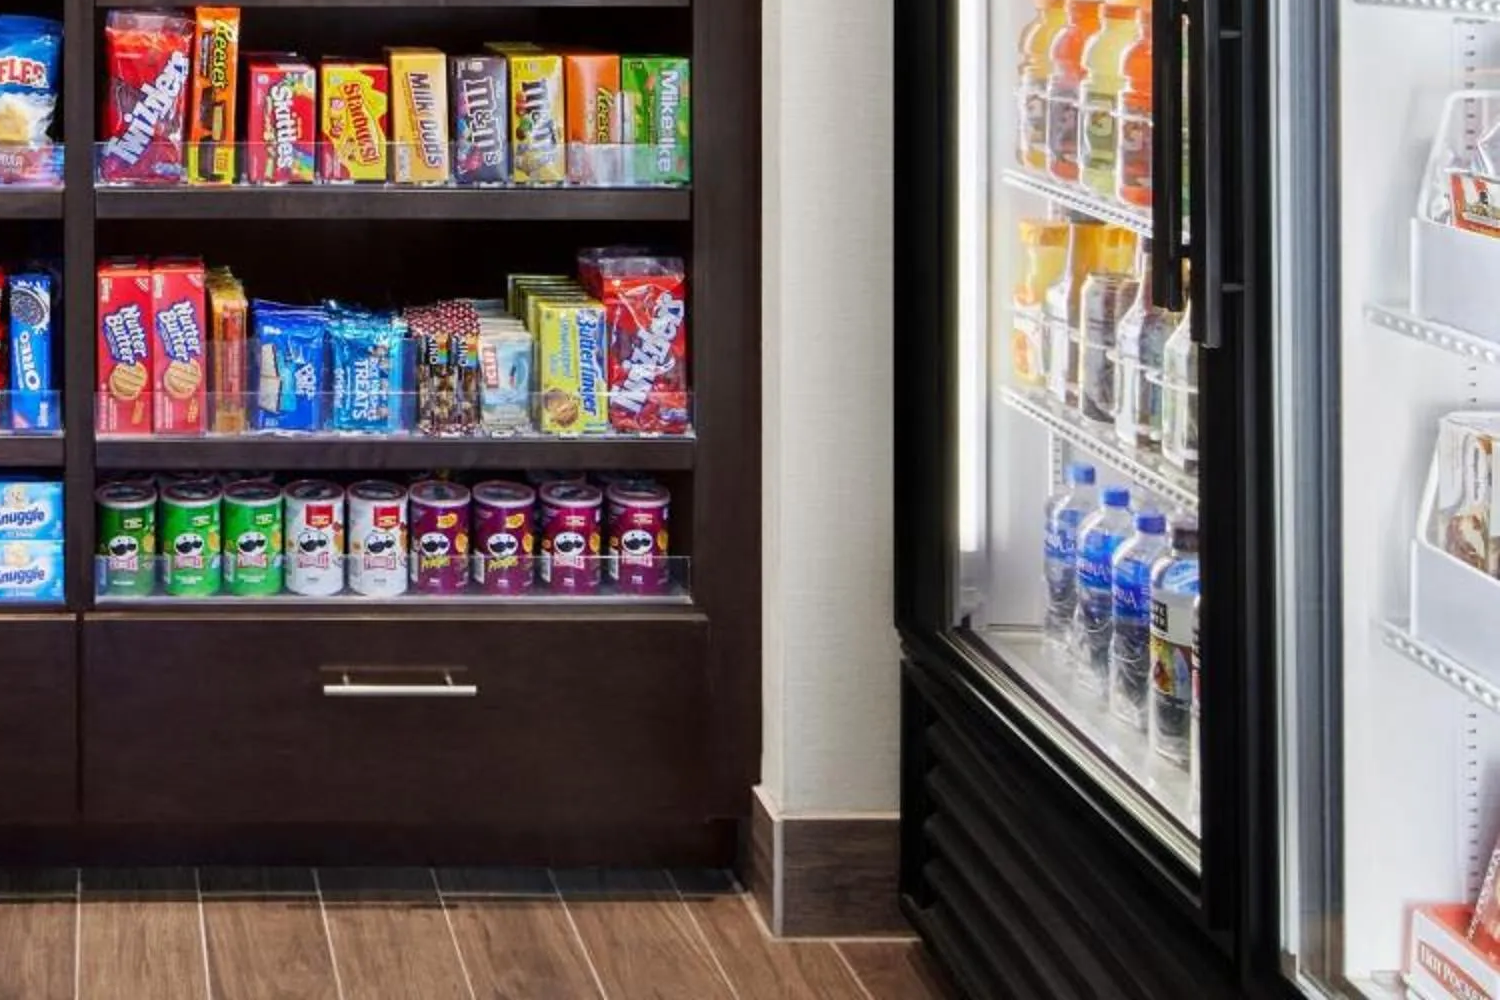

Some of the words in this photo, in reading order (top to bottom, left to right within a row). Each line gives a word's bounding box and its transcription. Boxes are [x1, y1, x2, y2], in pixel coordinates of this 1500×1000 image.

[211, 19, 238, 90] Reese's
[270, 85, 297, 169] Skittles
[104, 312, 136, 363] Butter
[119, 303, 147, 358] Nutter
[158, 309, 190, 361] Butter
[172, 299, 202, 355] Nutter
[429, 336, 440, 366] KIND
[19, 331, 42, 392] OREO
[353, 357, 368, 420] TREATS
[577, 310, 597, 417] Butterfinger
